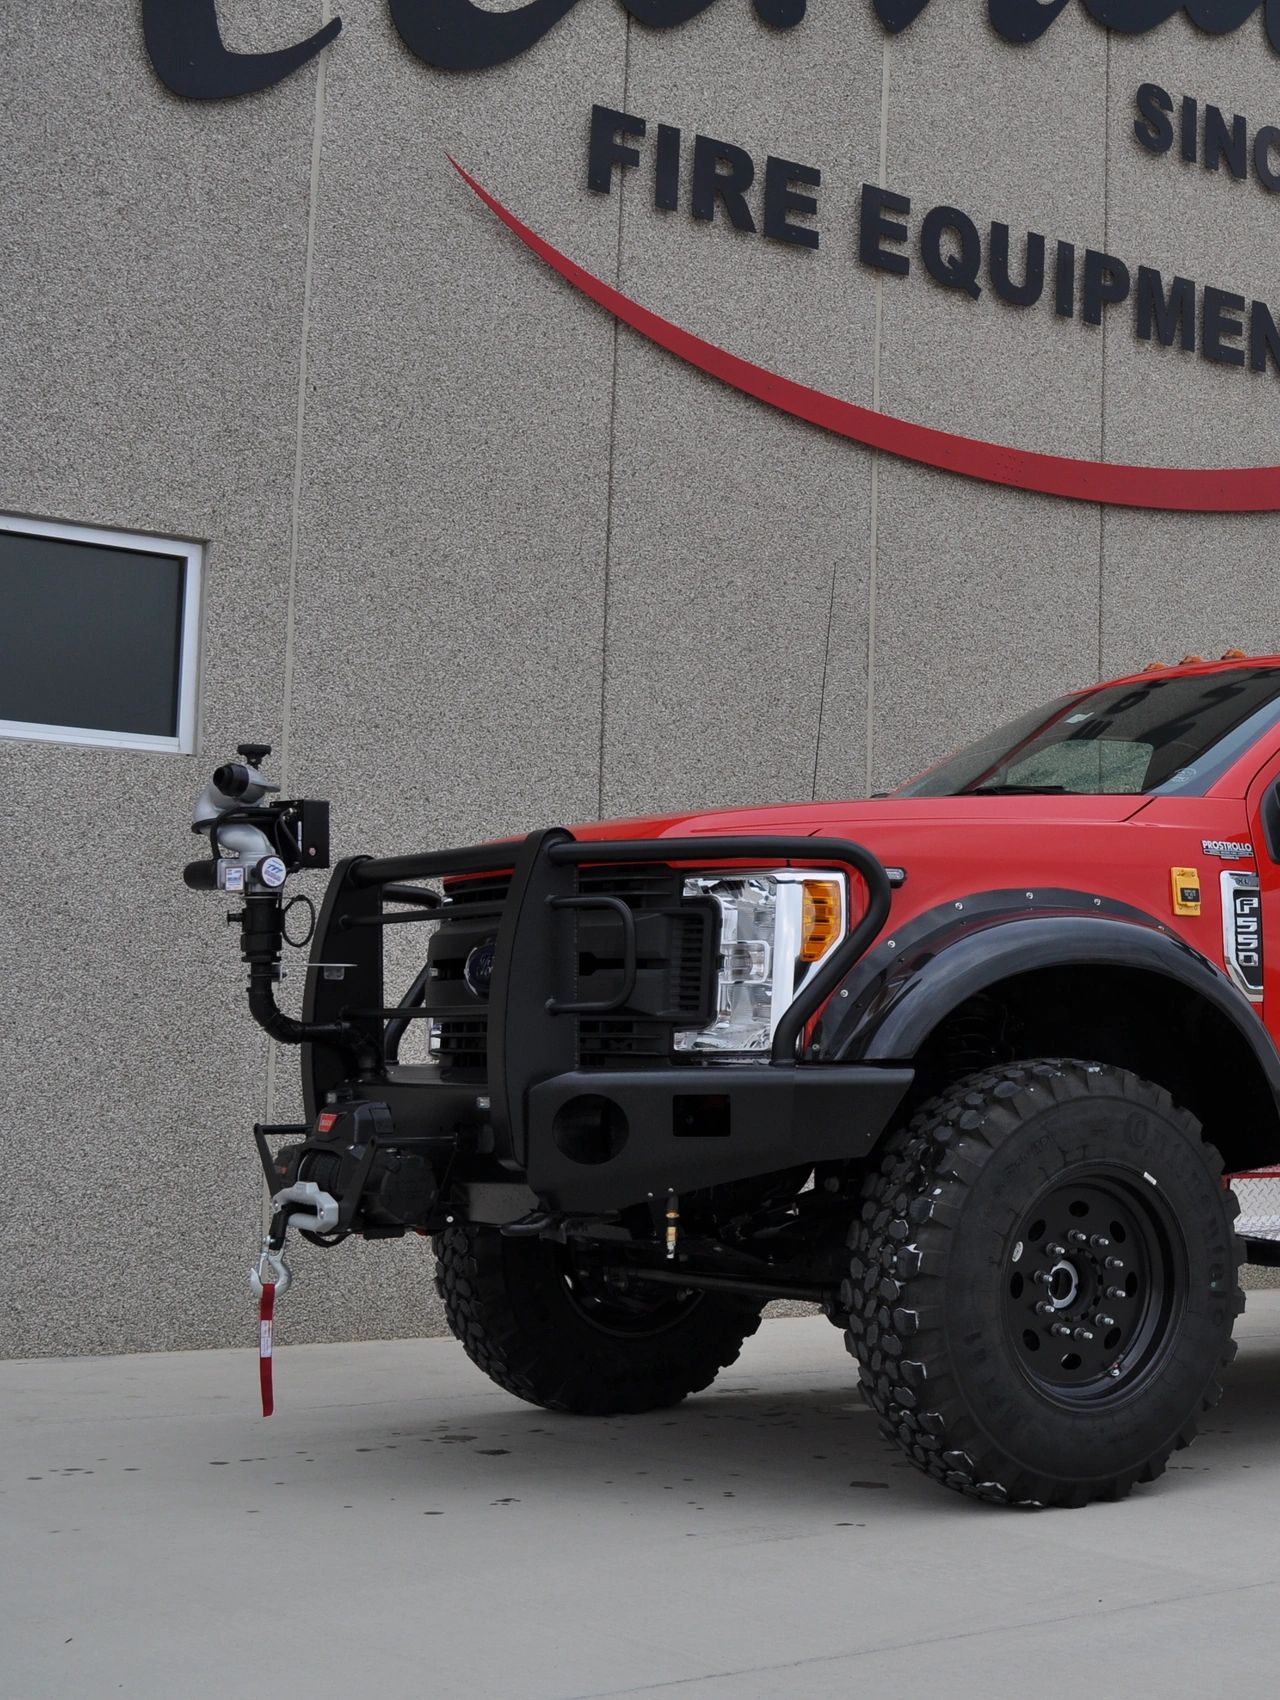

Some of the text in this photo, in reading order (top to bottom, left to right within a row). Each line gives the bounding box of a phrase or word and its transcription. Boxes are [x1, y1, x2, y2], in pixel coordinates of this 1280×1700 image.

[587, 104, 821, 250] FIRE
[1202, 840, 1252, 850] PROSTROLLO
[1236, 897, 1258, 966] F550
